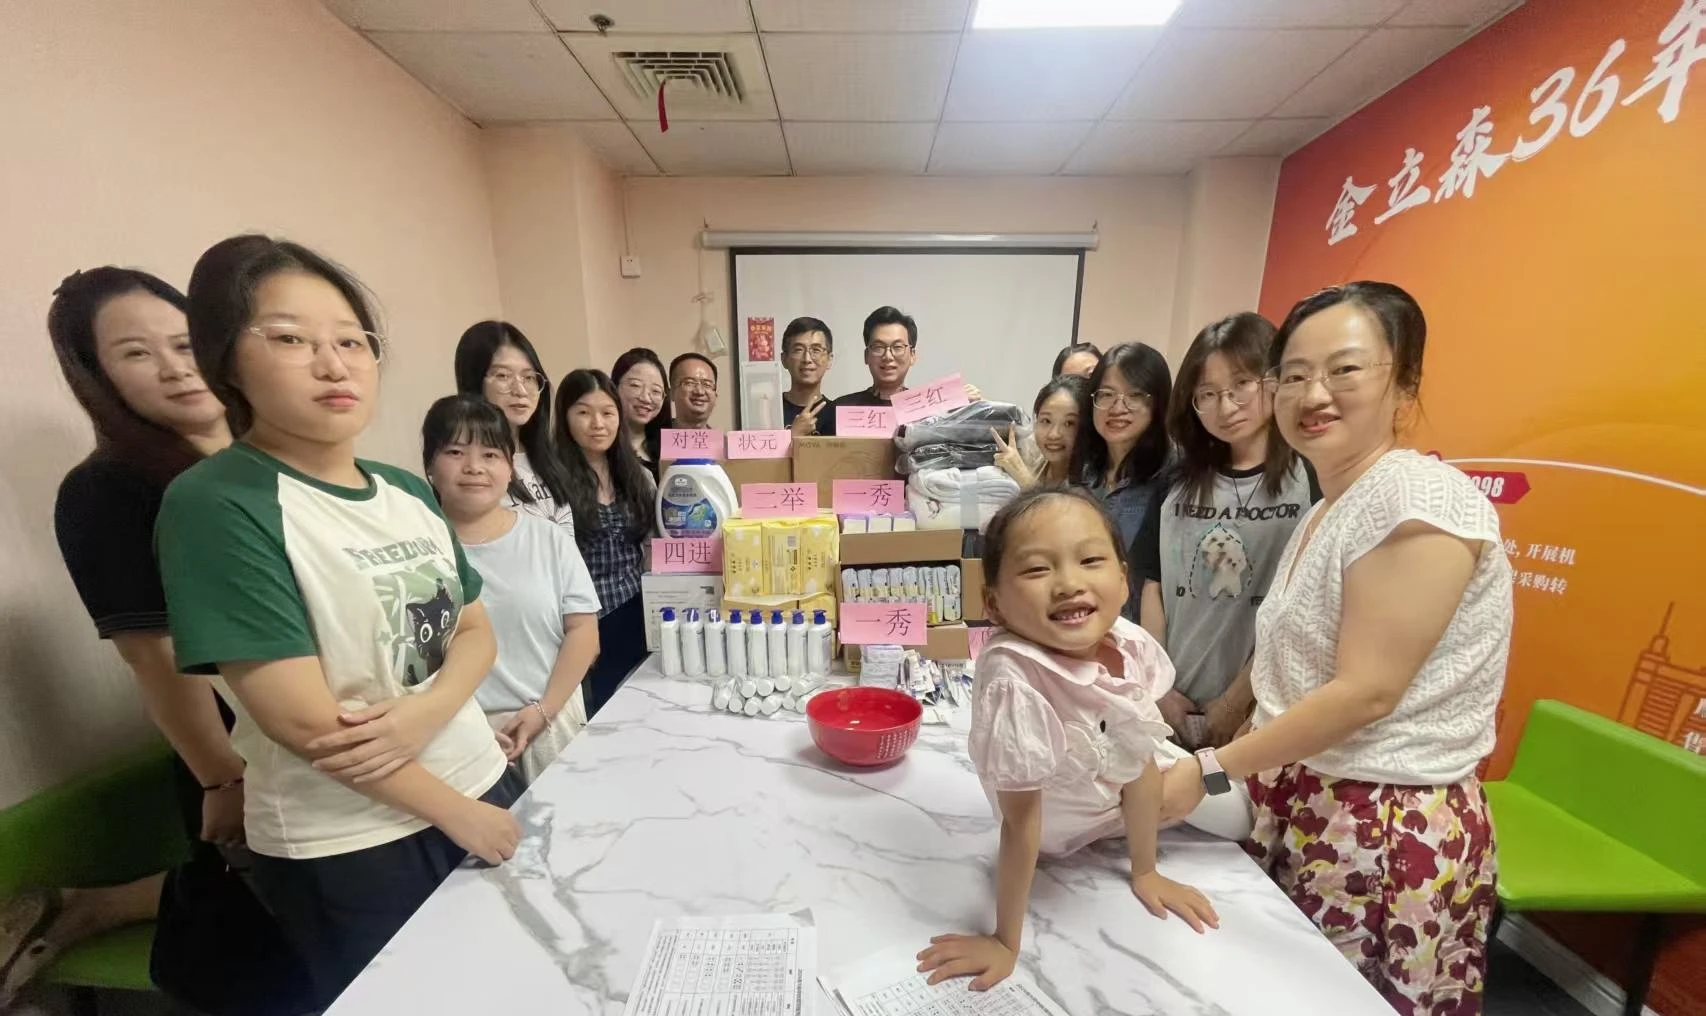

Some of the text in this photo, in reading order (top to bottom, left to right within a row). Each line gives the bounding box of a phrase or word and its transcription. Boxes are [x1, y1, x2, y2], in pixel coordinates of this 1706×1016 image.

[905, 386, 948, 412] 三红
[848, 410, 886, 429] 三红
[672, 432, 709, 449] 对堂
[738, 434, 777, 450] 状元
[754, 487, 805, 511] 二举
[844, 484, 892, 507] 一秀
[1174, 503, 1179, 517] I
[1218, 506, 1232, 520] A
[1235, 502, 1300, 521] DOCTOR
[665, 542, 712, 565] 四进
[856, 609, 911, 636] 一秀
